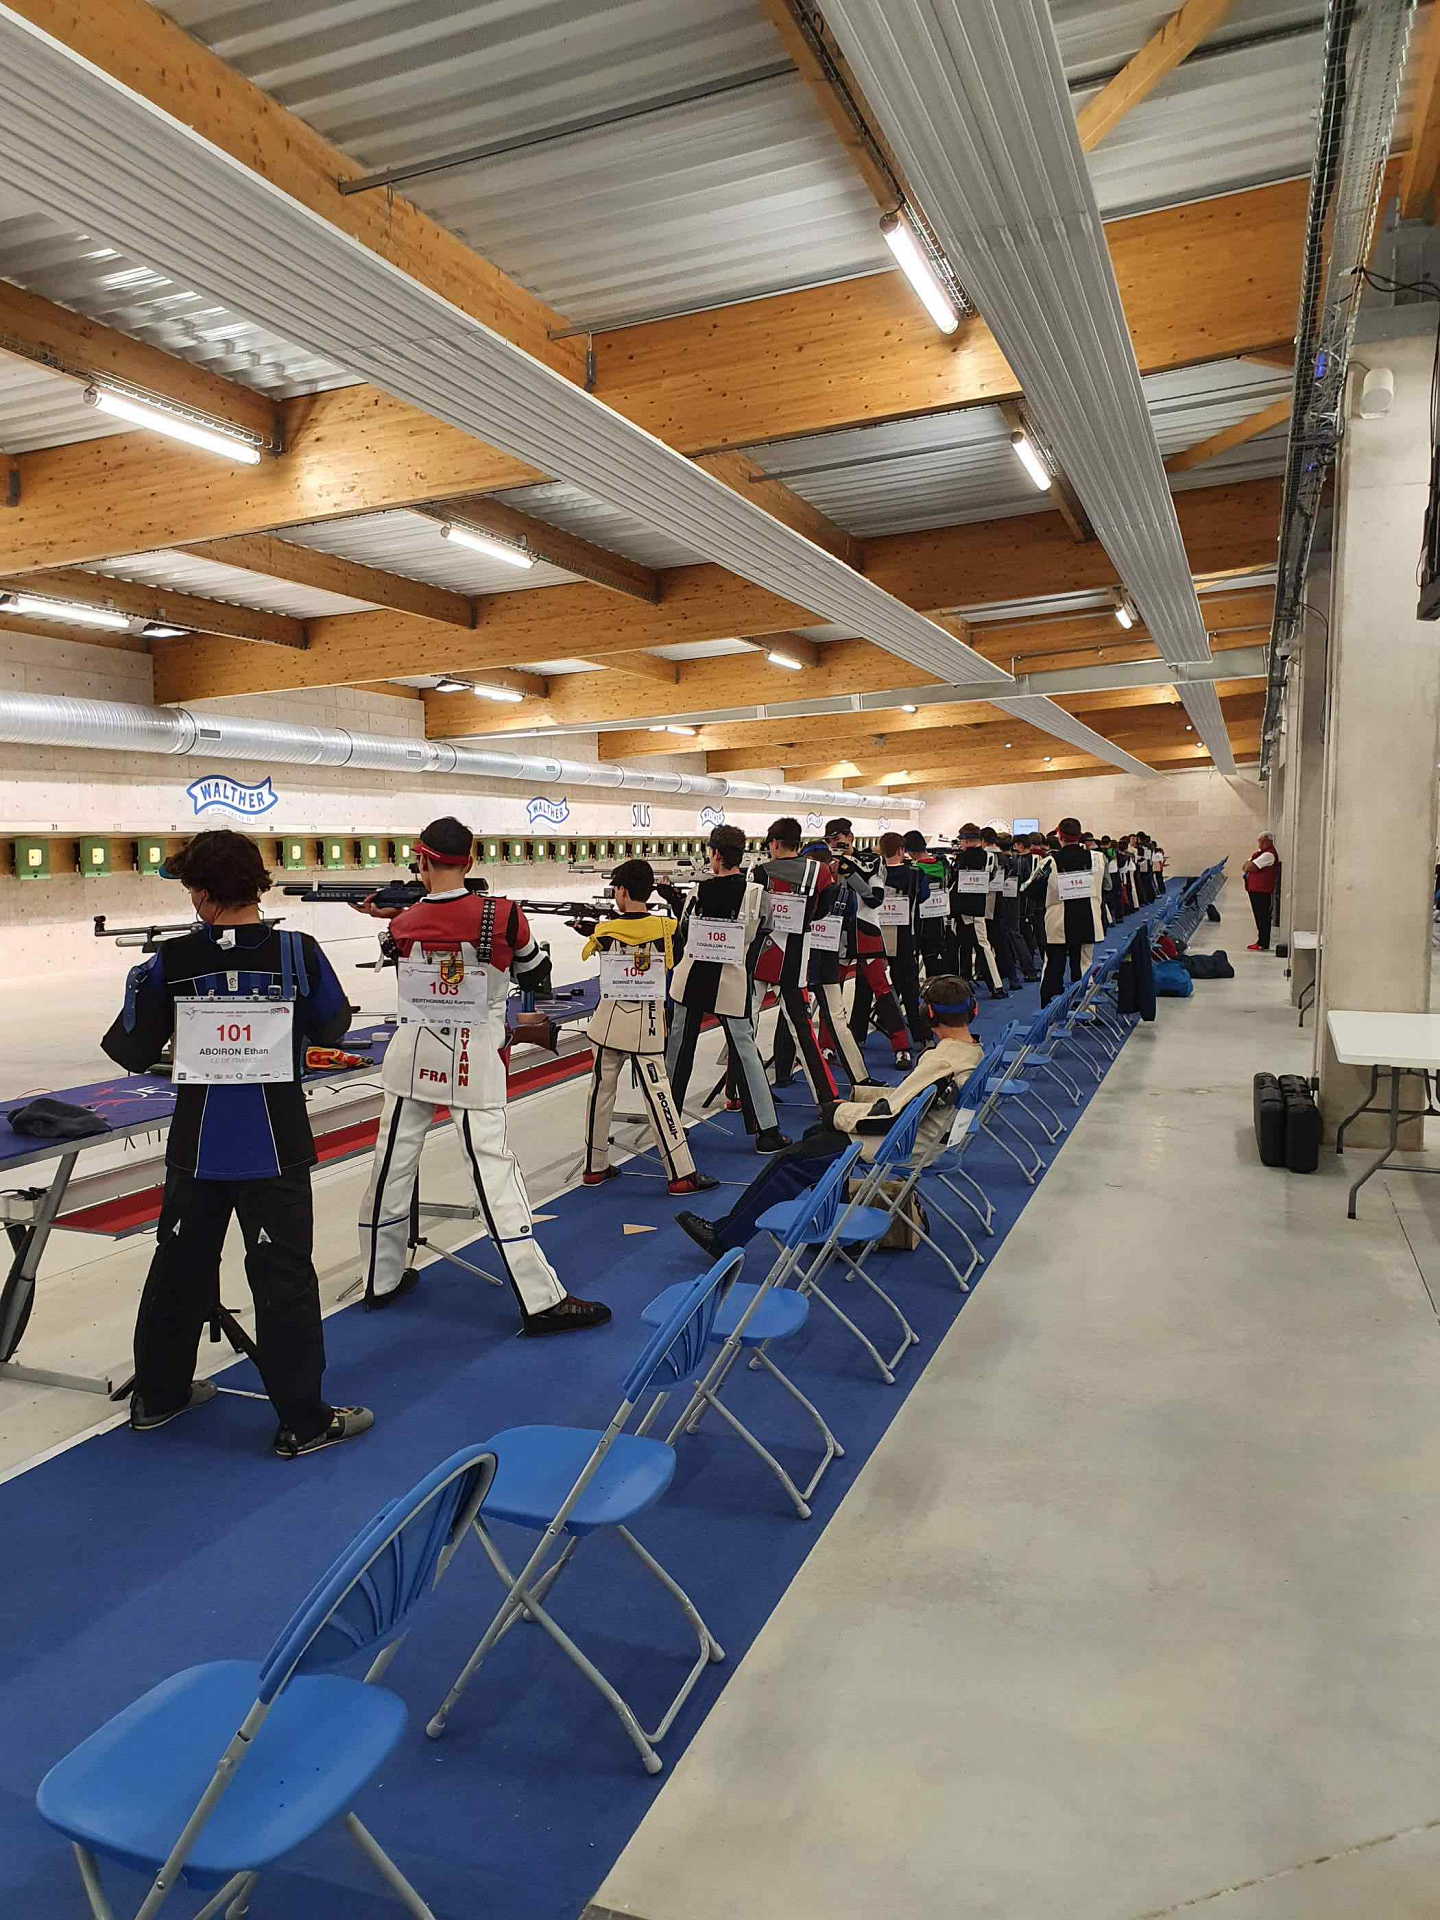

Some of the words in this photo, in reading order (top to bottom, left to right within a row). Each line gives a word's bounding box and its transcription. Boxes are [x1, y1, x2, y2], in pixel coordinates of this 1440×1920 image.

[201, 782, 265, 808] WALTHER
[533, 801, 564, 819] WALTHER
[632, 804, 651, 827] SIUS
[771, 903, 789, 913] 105
[707, 931, 726, 942] 108
[811, 924, 826, 933] 109
[429, 981, 459, 995] 103
[648, 1000, 656, 1037] ELIN
[216, 1024, 252, 1042] 101
[199, 1047, 242, 1056] ABOIRON
[244, 1047, 269, 1055] Ethan
[458, 1027, 470, 1087] RYANN
[419, 1068, 448, 1084] FRA
[656, 1091, 678, 1140] BONNET
